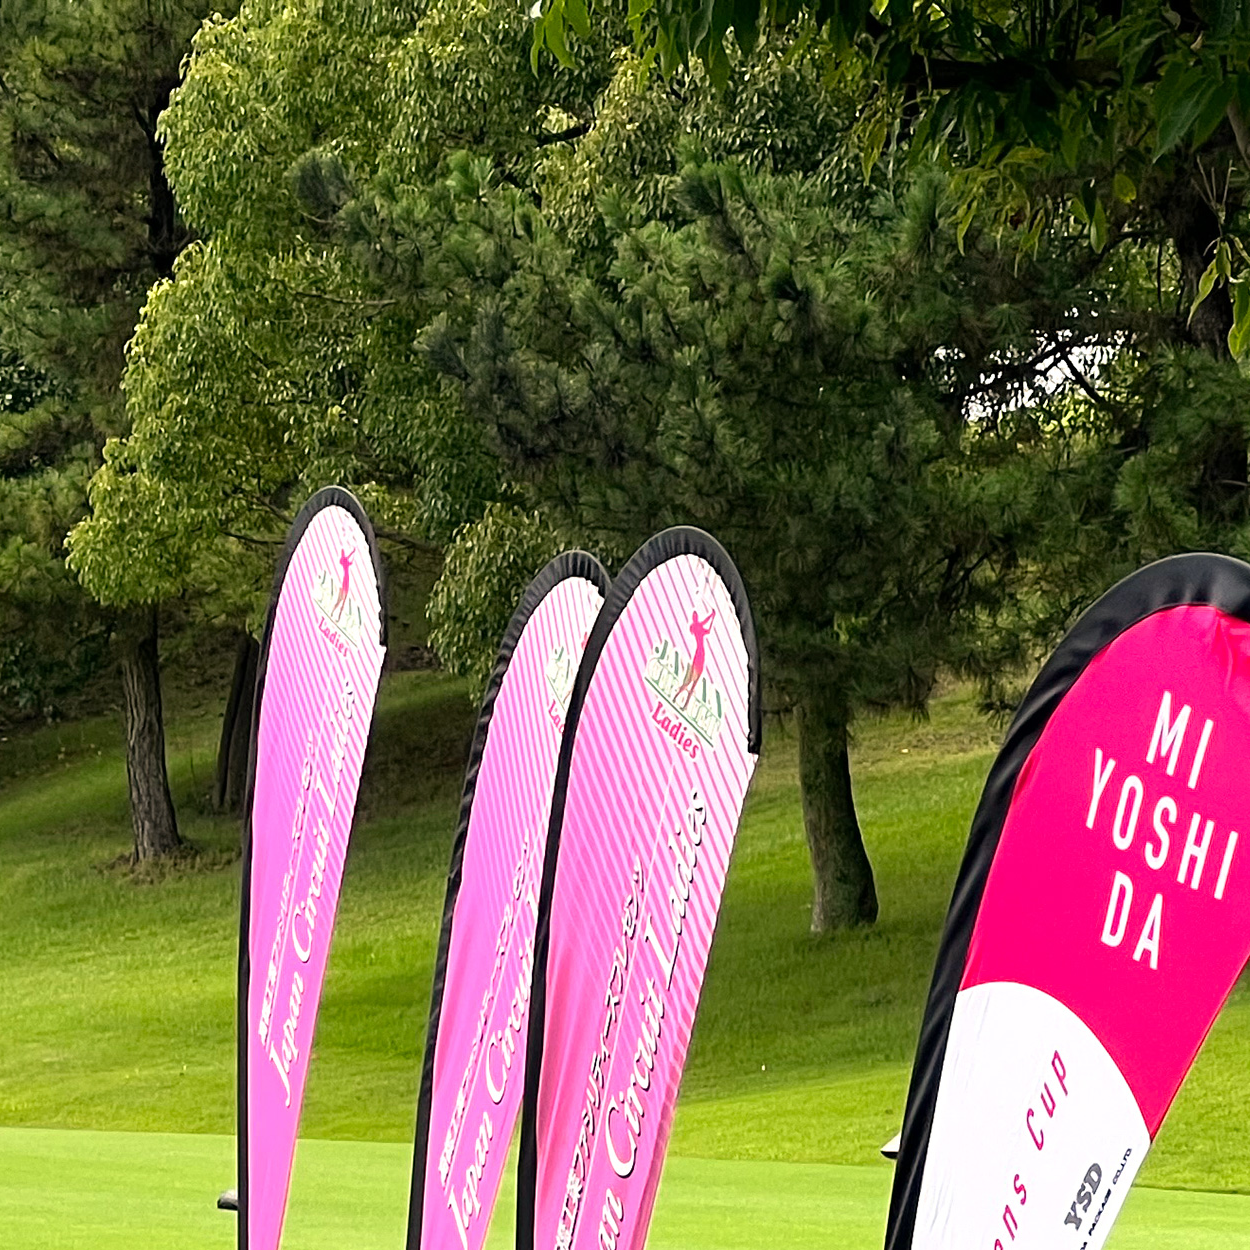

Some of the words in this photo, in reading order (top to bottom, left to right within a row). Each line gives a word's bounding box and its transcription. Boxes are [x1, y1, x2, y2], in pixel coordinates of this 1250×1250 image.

[318, 615, 349, 658] Ladies
[651, 701, 700, 760] Ladies
[1146, 690, 1214, 790] MI
[1085, 747, 1239, 901] YOSHI
[269, 971, 303, 1108] Japan
[292, 817, 330, 964] Circuit
[1100, 870, 1163, 971] DA
[605, 977, 665, 1179] Circuit
[644, 787, 707, 993] Ladies
[1063, 1163, 1102, 1231] YSD
